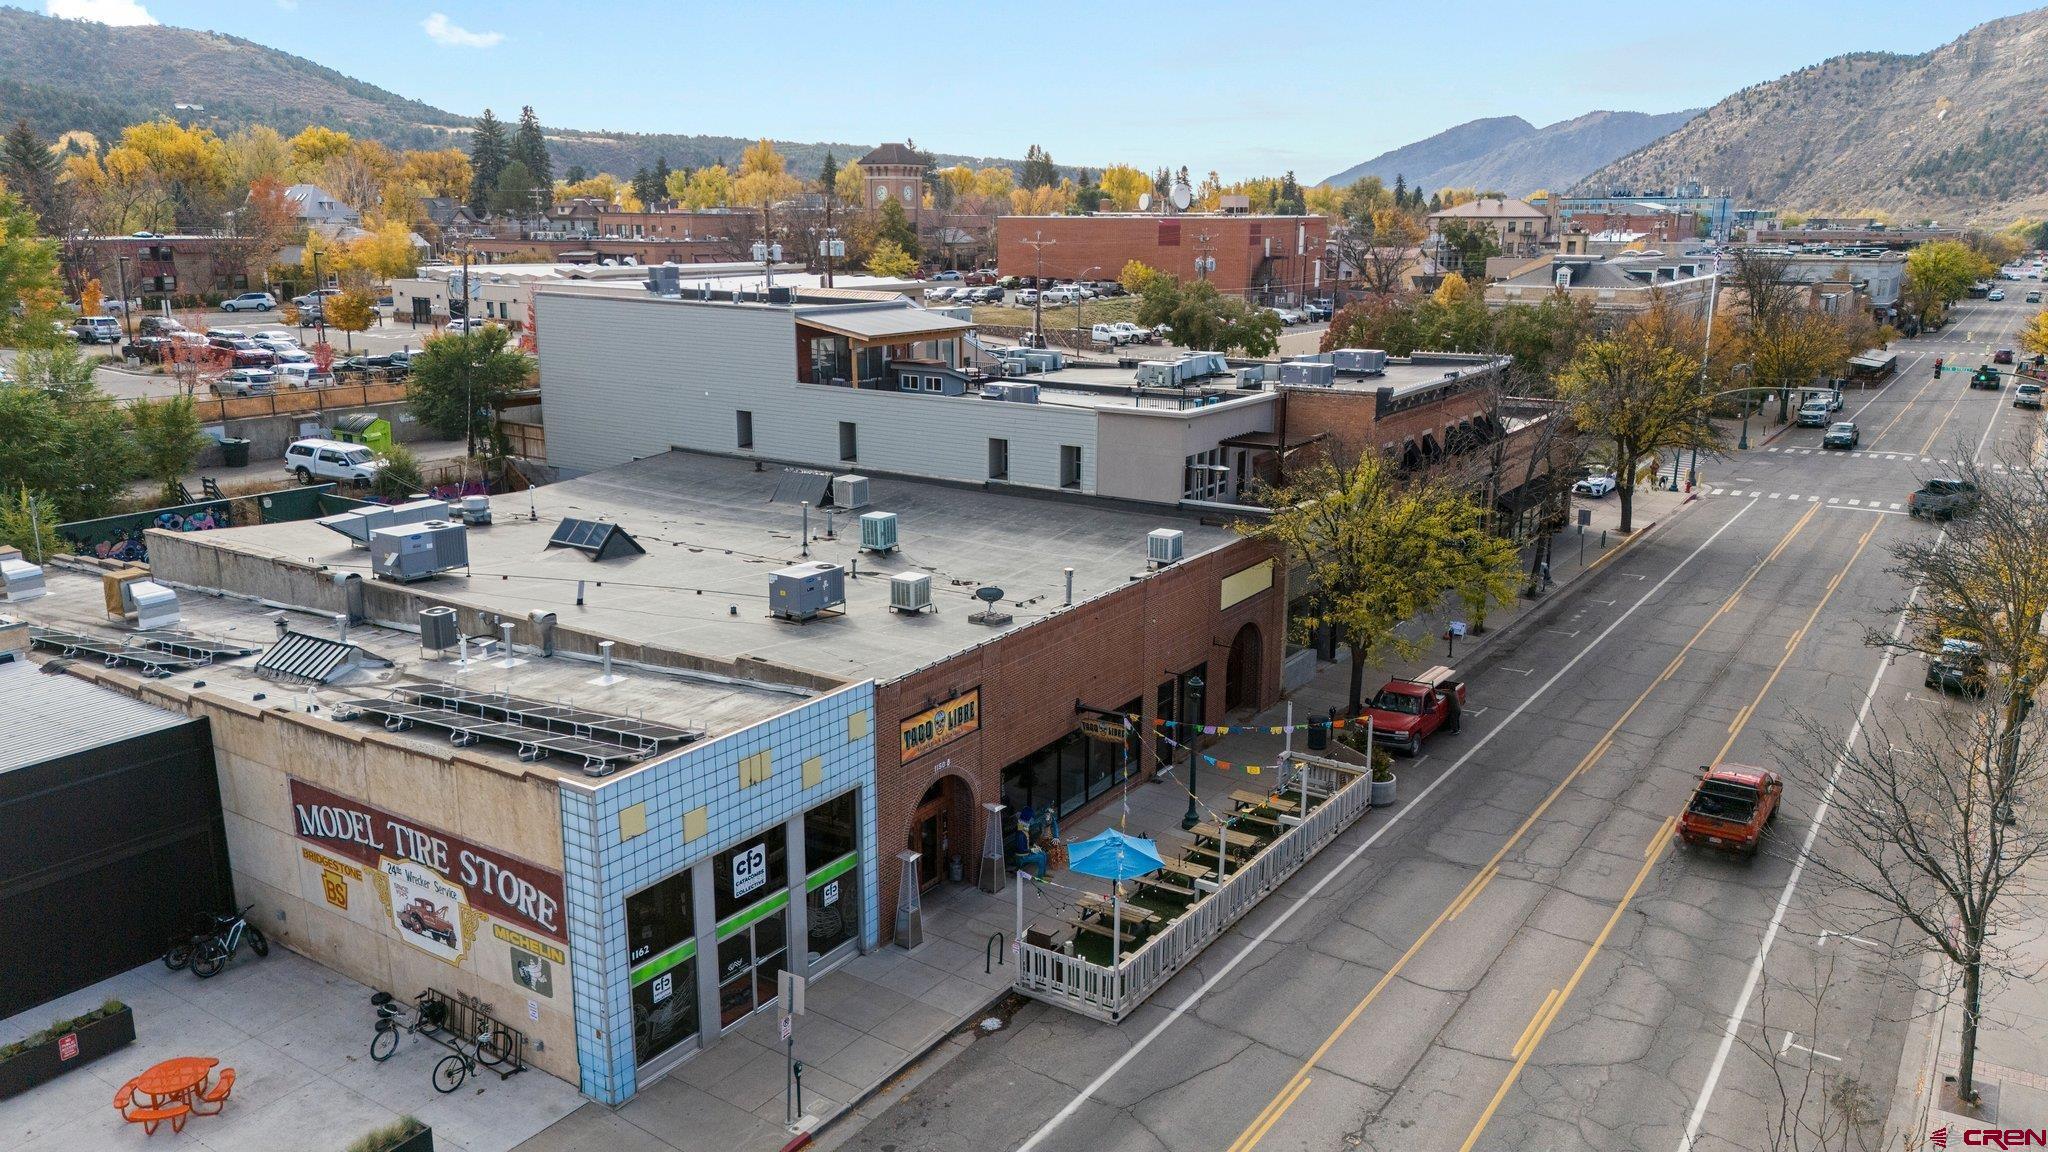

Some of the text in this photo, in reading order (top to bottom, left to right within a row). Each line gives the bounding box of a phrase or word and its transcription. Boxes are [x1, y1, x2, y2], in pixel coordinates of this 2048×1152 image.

[904, 720, 933, 750] TACO
[948, 701, 975, 730] LIBRE
[1081, 721, 1099, 733] TACO
[296, 804, 558, 932] MODEL TIRE STORE
[302, 847, 363, 882] BRIDGESTONE
[735, 868, 765, 887] CATACOMBS
[327, 879, 345, 906] BS
[405, 869, 430, 889] Wrecker
[433, 880, 457, 900] Service
[735, 878, 765, 897] COLLECTIVE
[494, 926, 564, 963] MICHELIN
[631, 945, 650, 961] 1162
